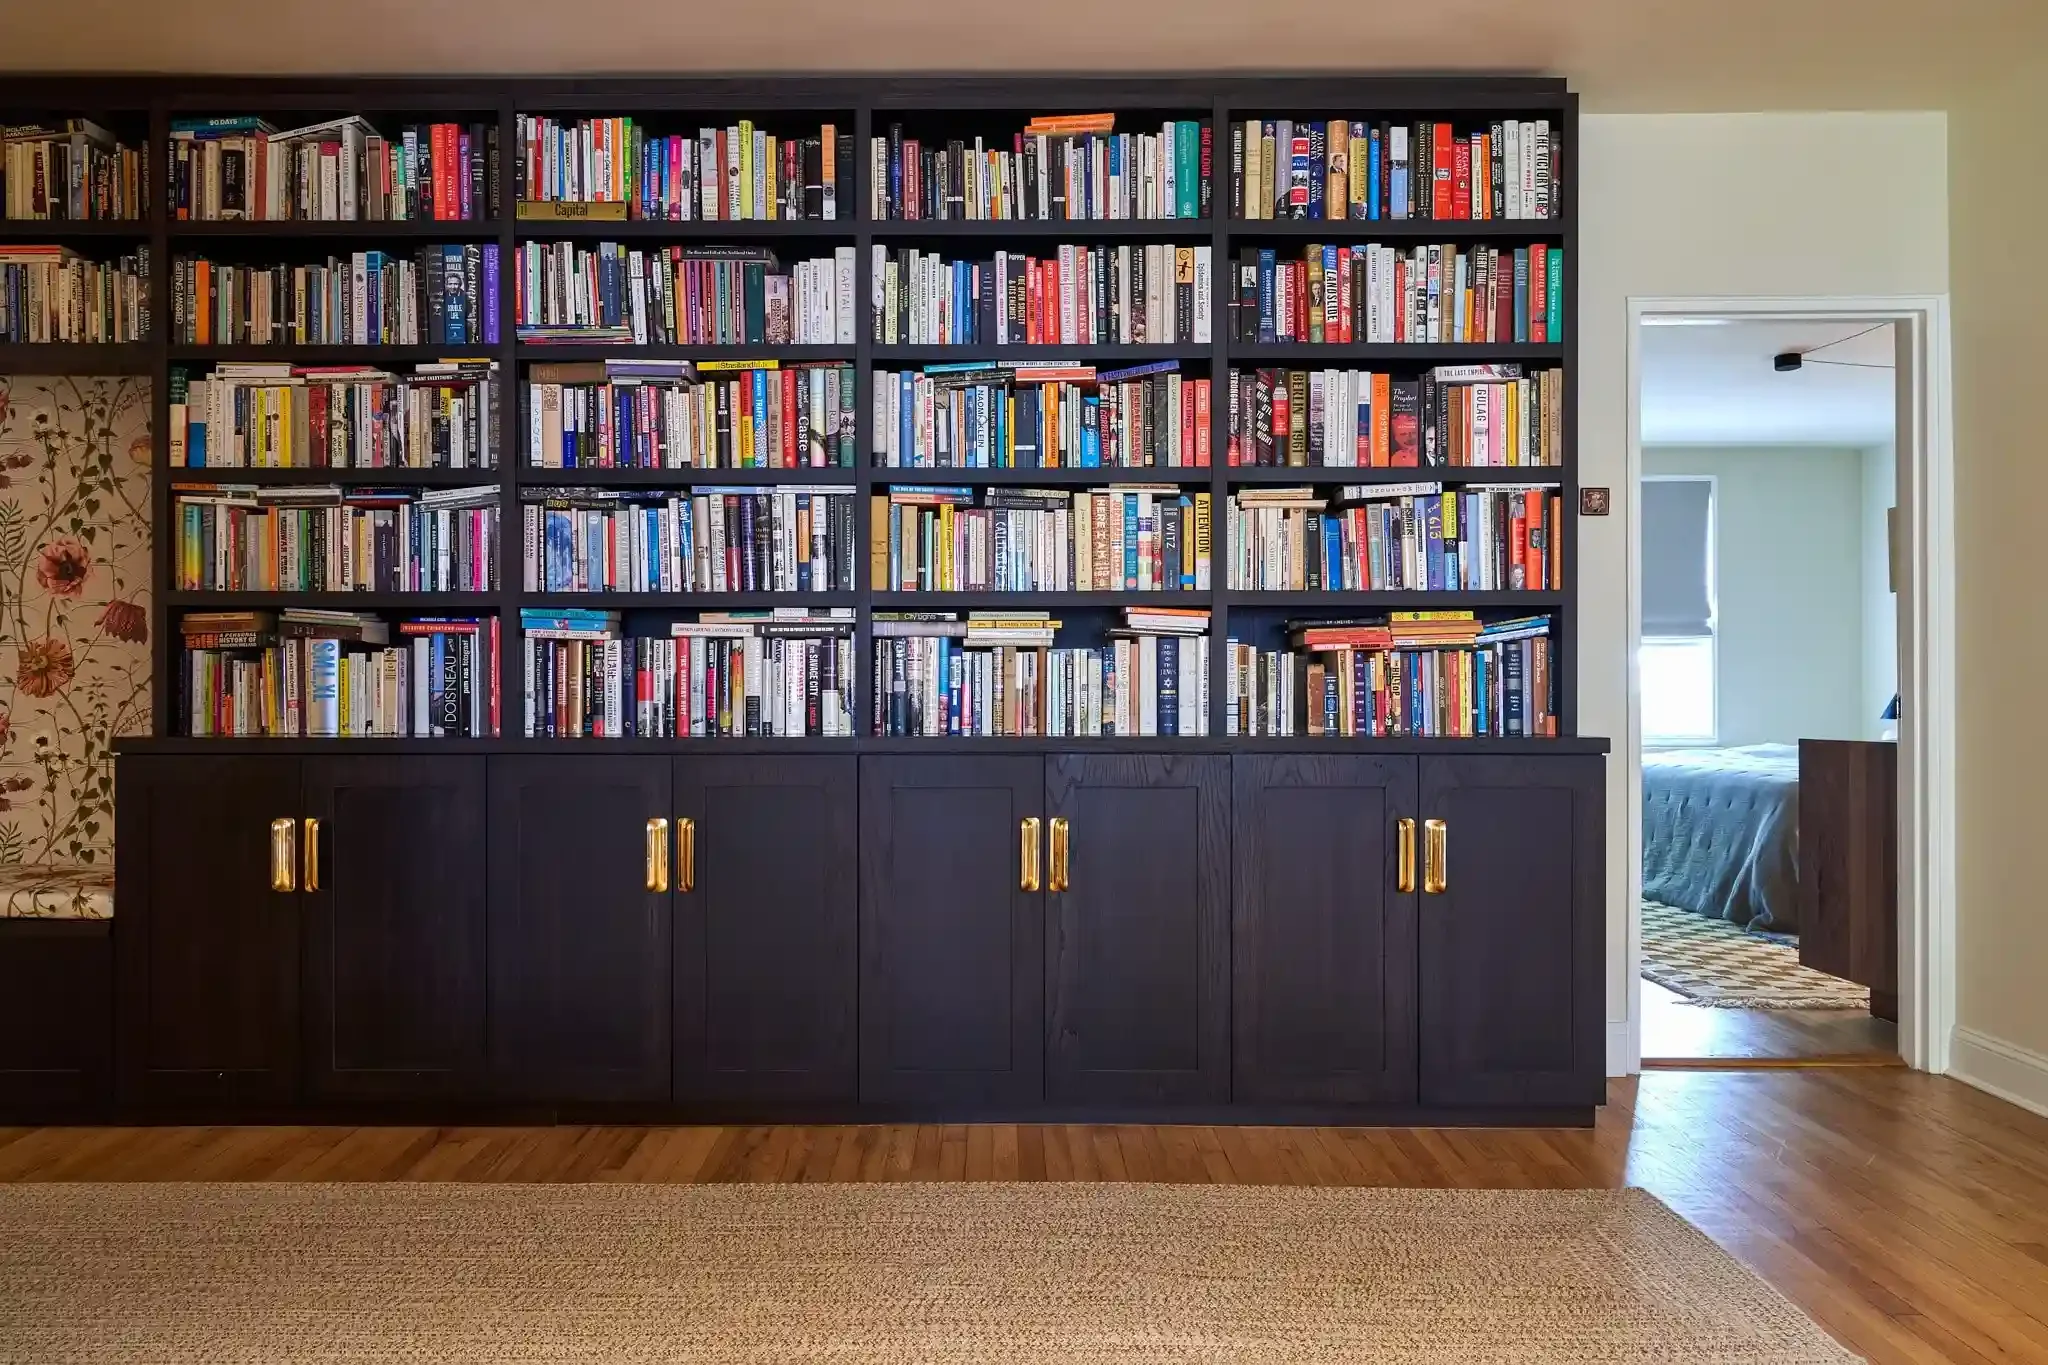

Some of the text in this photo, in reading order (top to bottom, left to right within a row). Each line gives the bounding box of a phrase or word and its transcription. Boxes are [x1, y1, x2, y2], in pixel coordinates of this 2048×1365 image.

[1202, 128, 1210, 176] BAD BLOOD
[1537, 134, 1547, 150] THE
[404, 138, 415, 190] HALFWAY HOME
[1537, 152, 1547, 189] VICTORY
[555, 201, 587, 216] Capital
[468, 247, 480, 300] Cheever
[1476, 252, 1487, 286] FIERY TRIAL
[356, 286, 364, 322] Sapiens
[841, 267, 850, 311] CAPITAL
[1078, 256, 1086, 335] KEYNES HAYEK
[1326, 272, 1337, 321] LANDSLIDE
[1340, 282, 1350, 308] TOWN
[1008, 296, 1016, 320] ENEMIES
[1229, 372, 1238, 414] STRONGMEN
[1477, 390, 1486, 422] GULAG
[1292, 374, 1303, 453] BERLIN 1961
[798, 416, 809, 452] Caste
[1100, 410, 1109, 461] CORRECTIONS
[679, 502, 689, 524] Rudy!
[1097, 499, 1106, 528] HERE
[1199, 500, 1209, 553] ATTENTION
[1097, 542, 1106, 559] AM
[1166, 522, 1175, 549] WITZ
[808, 654, 818, 680] SAVAGE
[444, 656, 456, 722] DOISNEAU
[808, 682, 818, 698] CITY
